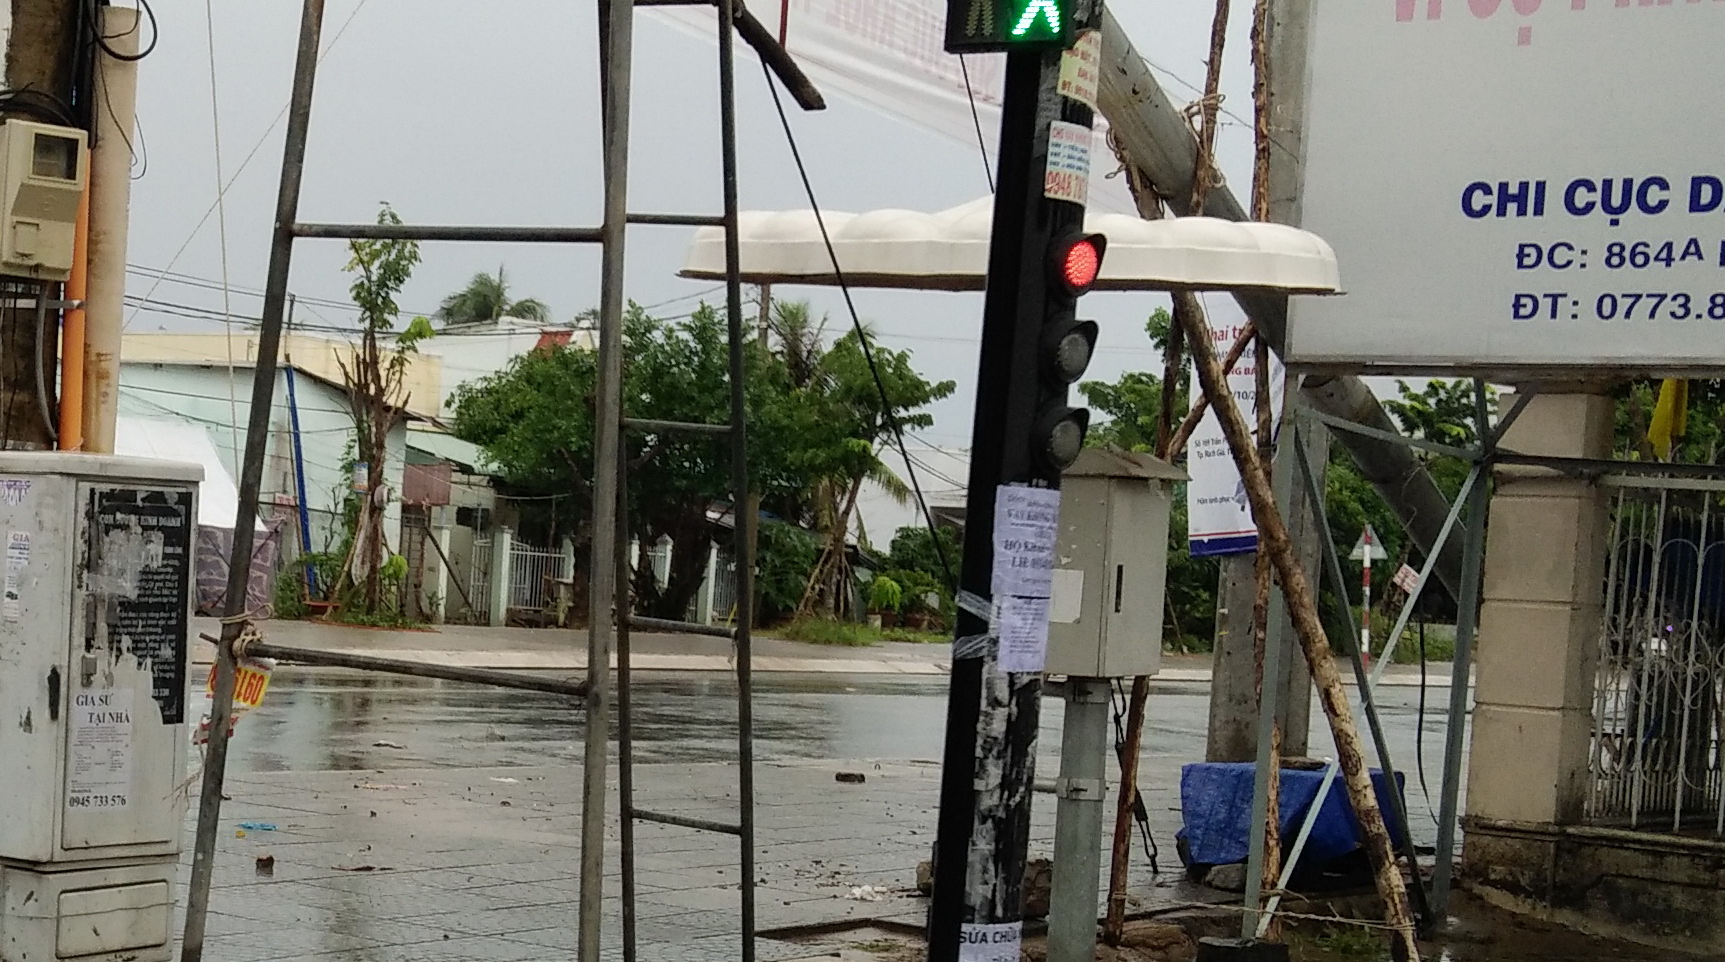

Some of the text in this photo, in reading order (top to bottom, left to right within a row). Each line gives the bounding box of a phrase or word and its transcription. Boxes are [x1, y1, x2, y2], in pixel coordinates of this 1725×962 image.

[1461, 175, 1725, 226] CHI CỤC D
[1516, 237, 1705, 269] ĐC: 864A
[1511, 292, 1580, 320] ĐT:
[76, 694, 96, 706] GIA
[88, 712, 106, 726] TẠI
